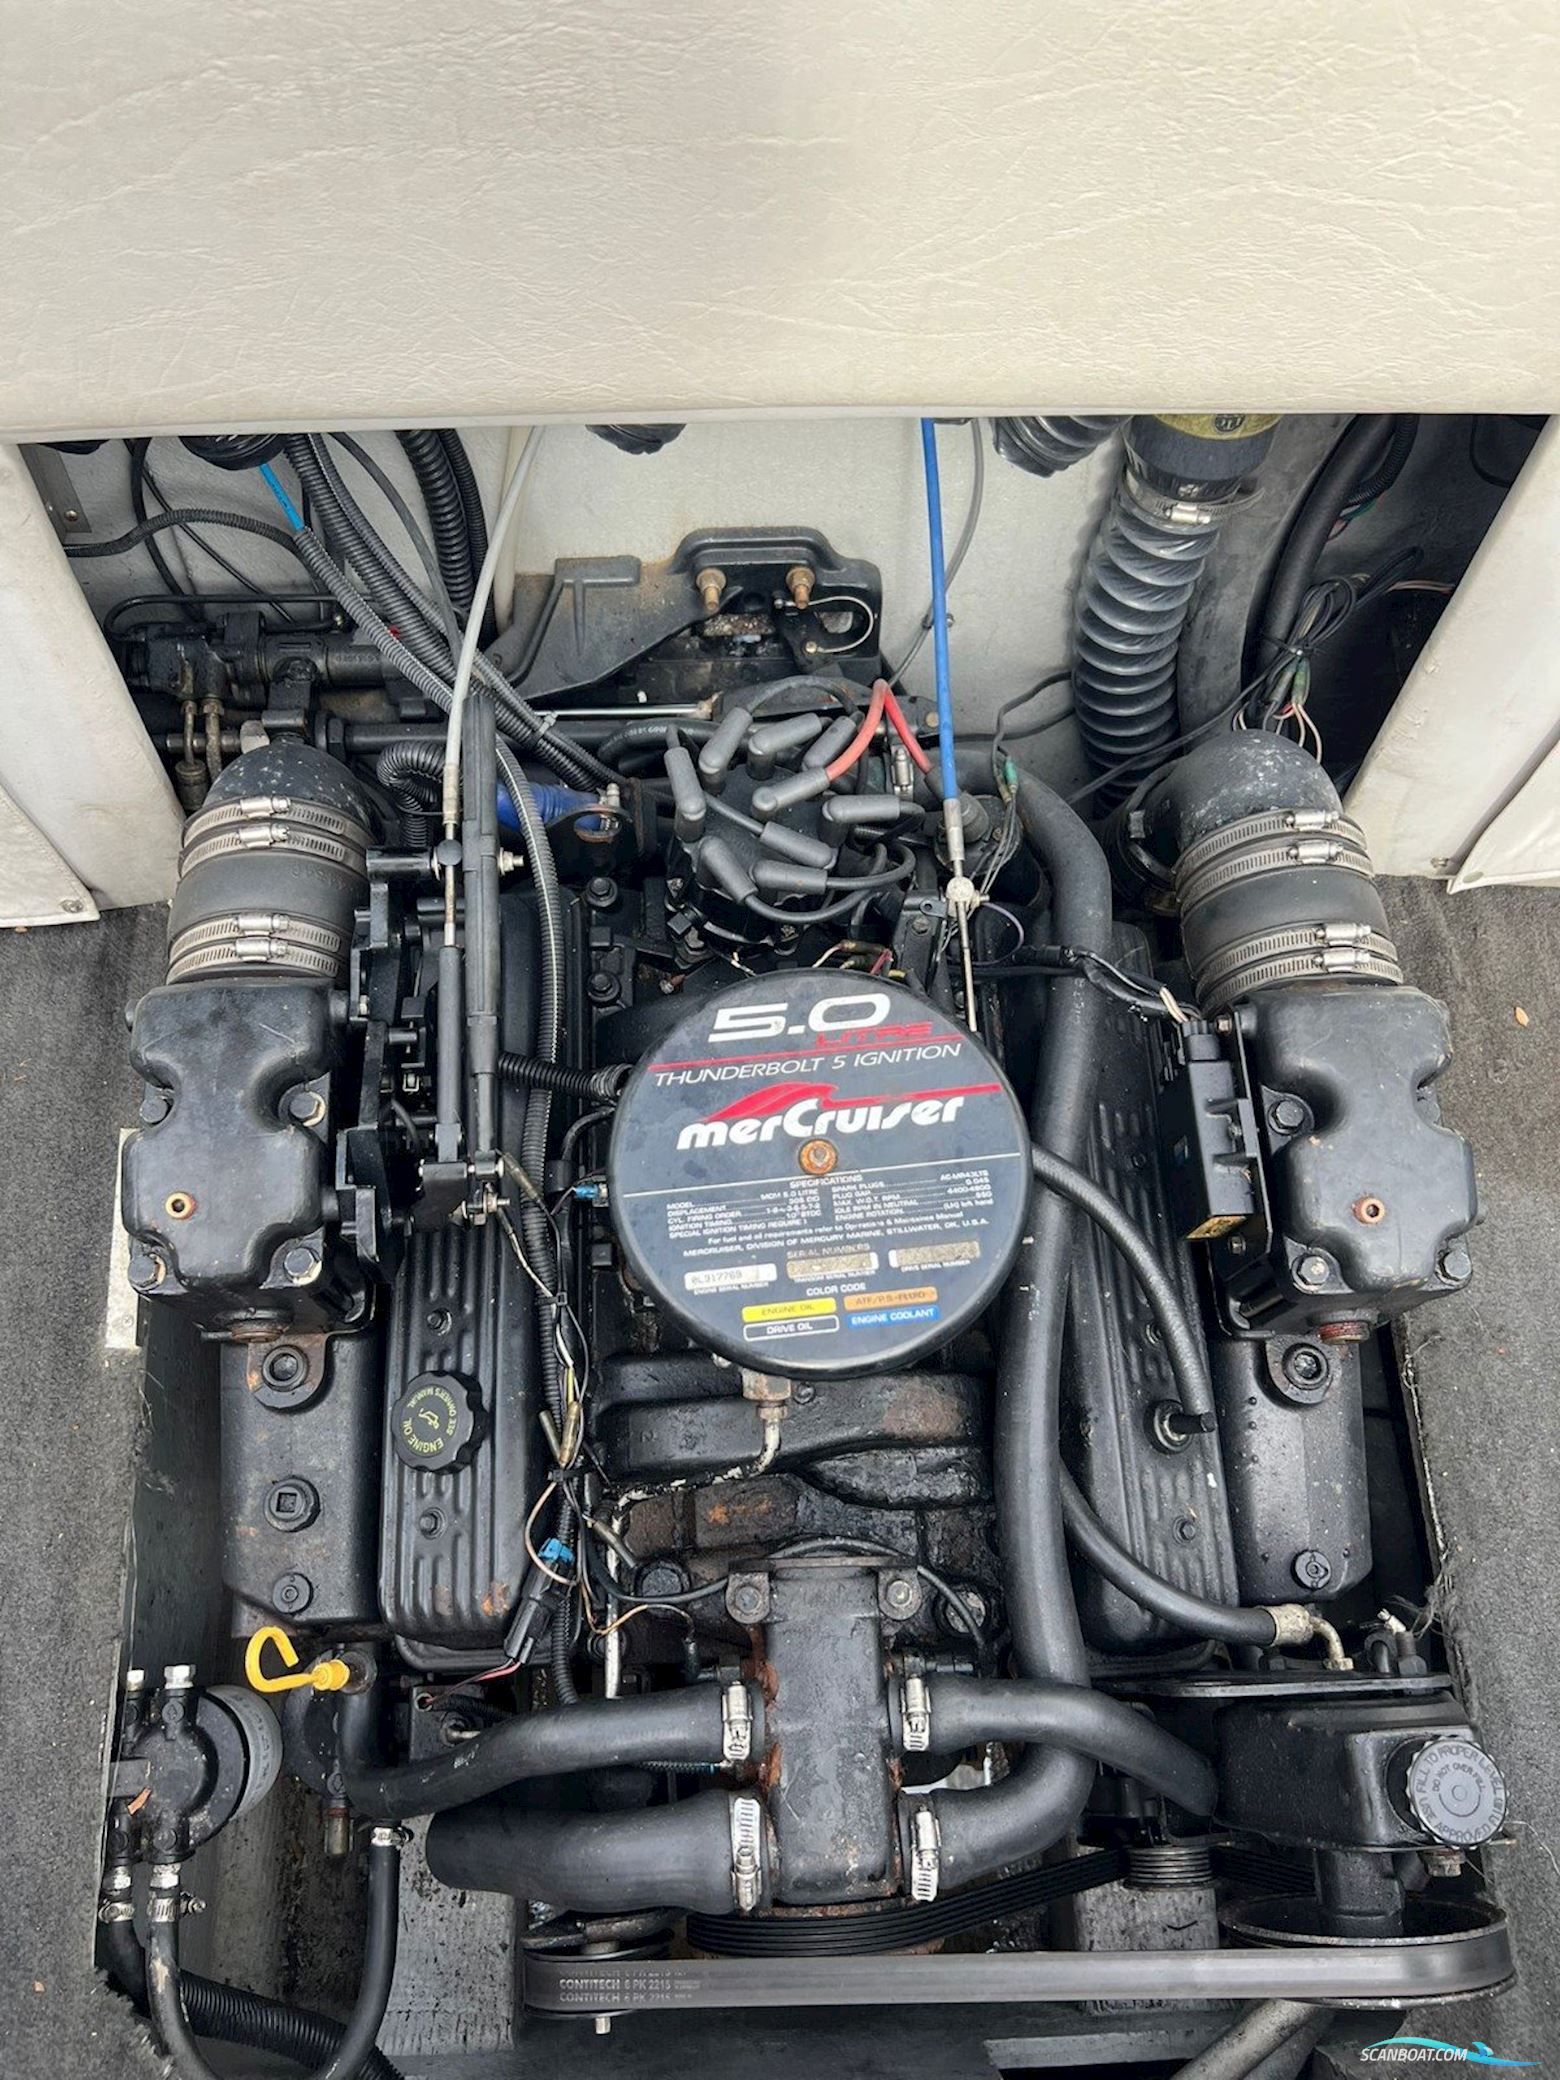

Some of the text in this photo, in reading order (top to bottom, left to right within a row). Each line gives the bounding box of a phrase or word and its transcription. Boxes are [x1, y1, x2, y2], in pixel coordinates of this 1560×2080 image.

[707, 993, 891, 1043] 5.0
[816, 1021, 933, 1047] LITRE
[655, 1043, 962, 1087] THUNDERBOLT 5 IGNITION
[790, 1174, 863, 1188] SPECIFICATIONS
[667, 1205, 727, 1217] DISPLACEMENT
[835, 1212, 865, 1221] ENGINE
[668, 1222, 703, 1232] IGNITION
[669, 1230, 701, 1239] SPECIAL
[703, 1227, 737, 1236] IGNITION
[723, 1235, 737, 1243] fuel
[738, 1234, 752, 1242] and
[764, 1228, 813, 1239] requirements
[936, 1211, 964, 1220] Manual
[746, 1241, 784, 1251] DIVISION
[786, 1238, 798, 1246] OF
[800, 1234, 843, 1245] MERCURY
[806, 1282, 867, 1297] COLOR CODE
[762, 1306, 796, 1316] ENGINE
[851, 1308, 935, 1325] ENGINE COOLANT
[766, 1322, 813, 1335] DRIVE OIL
[402, 1417, 444, 1453] ENGINE OIL
[1415, 1744, 1503, 1795] FILL TO PROPER LEVEL
[1432, 1779, 1441, 1792] DO
[1438, 1764, 1450, 1778] NOT
[1419, 1796, 1437, 1823] USE
[559, 1978, 620, 1990] CONTITECH
[632, 1979, 647, 1990] PK
[559, 1991, 620, 2003] CONTITECH
